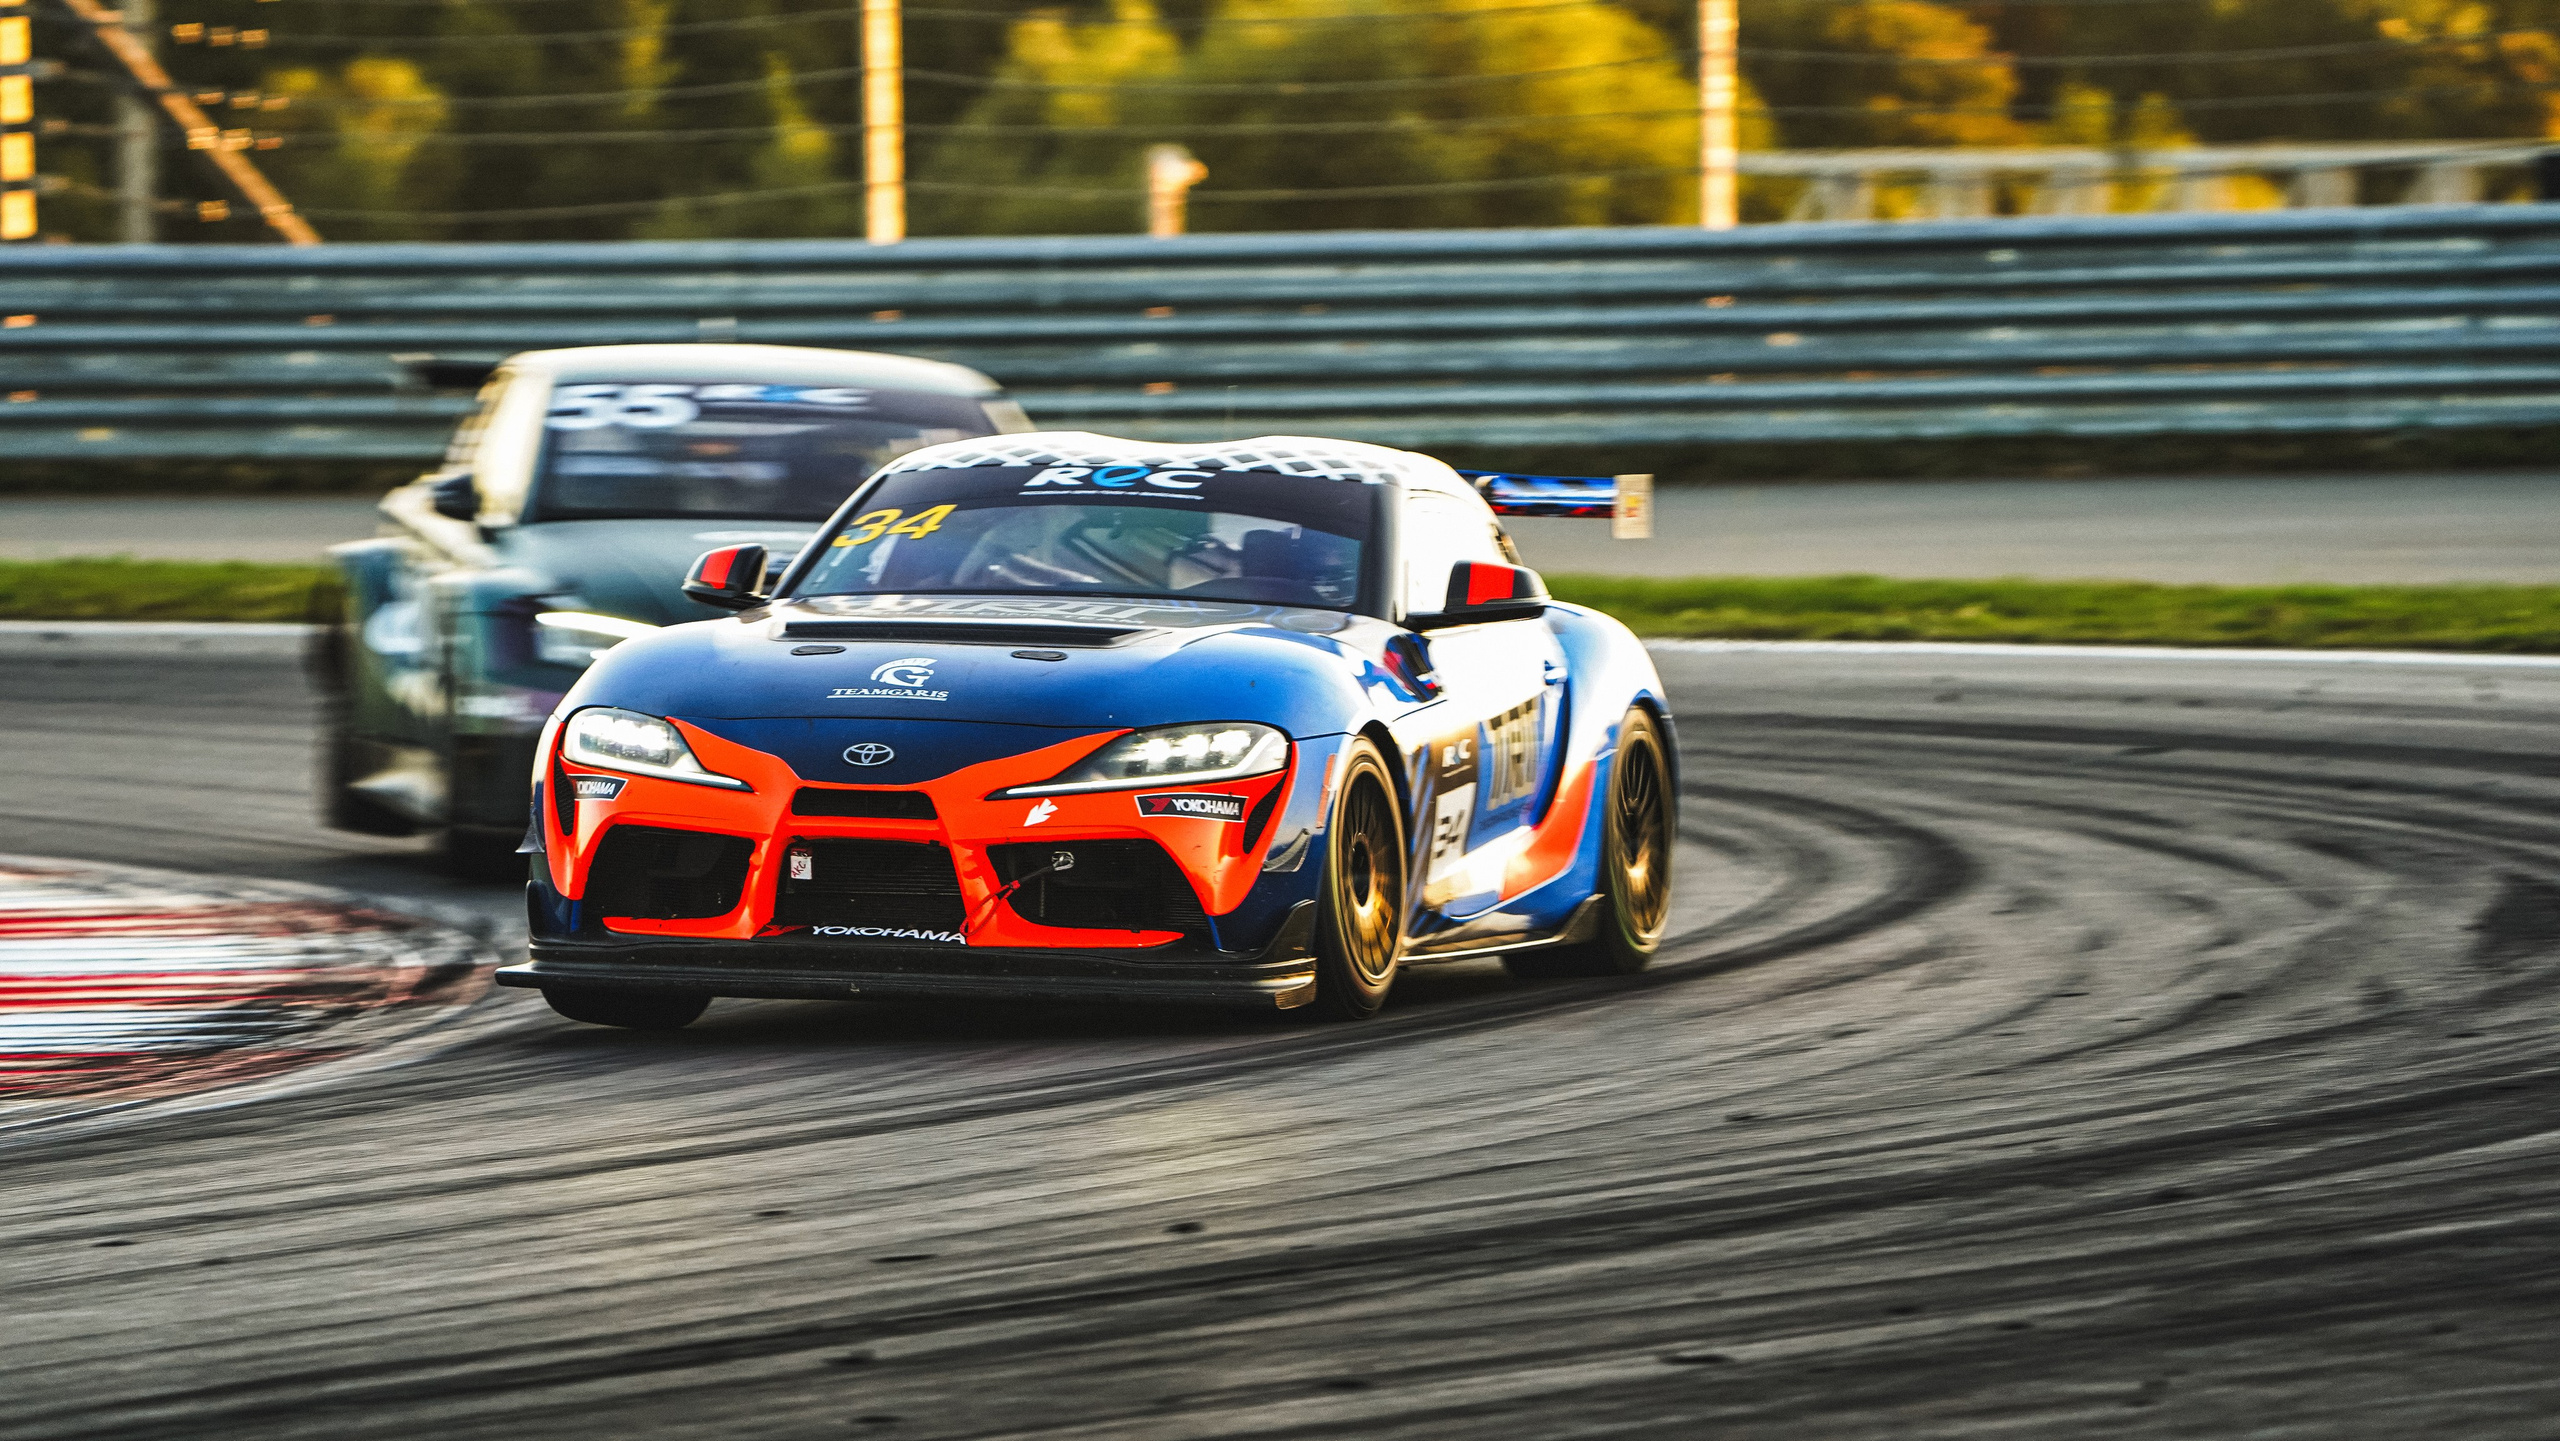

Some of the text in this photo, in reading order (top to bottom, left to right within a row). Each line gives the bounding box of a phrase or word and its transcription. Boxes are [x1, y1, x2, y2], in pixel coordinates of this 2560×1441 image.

[545, 384, 699, 430] 55
[831, 504, 958, 547] 34
[832, 688, 950, 698] TEAMGARIS
[1171, 799, 1240, 816] YOKOHAMA
[812, 926, 967, 945] YOKOHAMA
